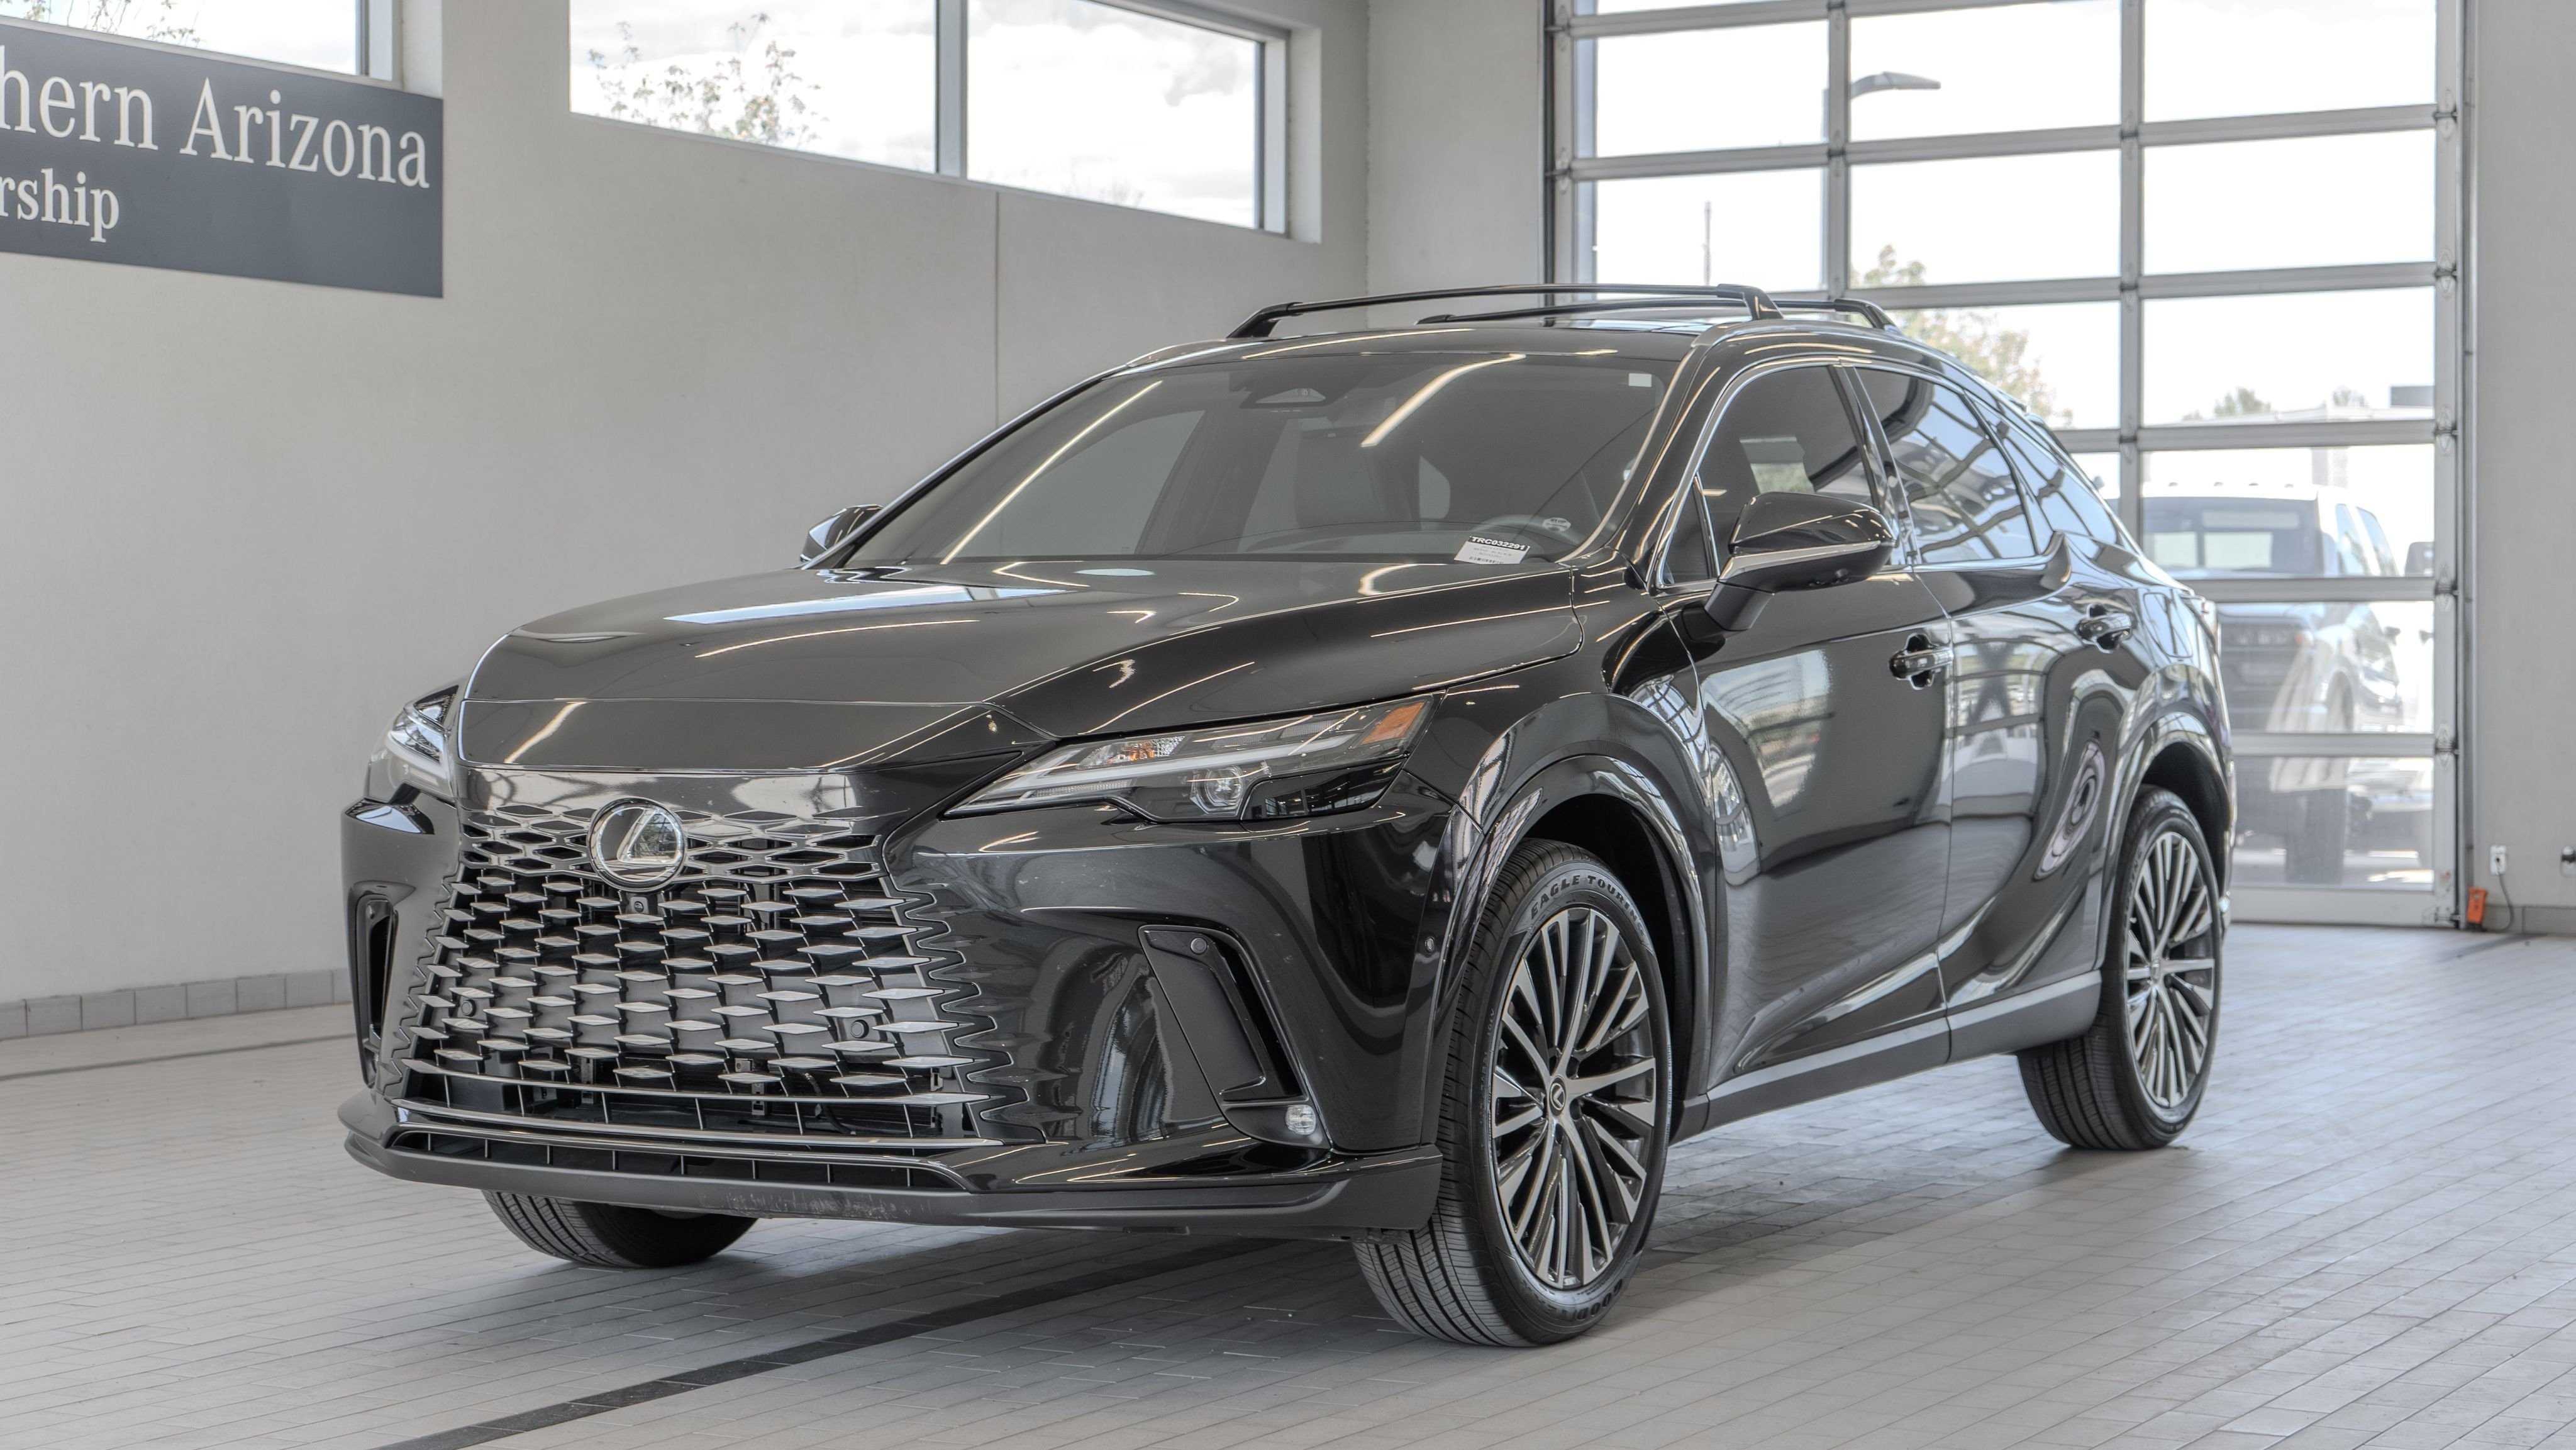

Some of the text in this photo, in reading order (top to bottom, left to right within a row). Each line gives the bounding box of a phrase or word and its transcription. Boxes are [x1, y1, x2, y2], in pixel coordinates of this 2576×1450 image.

[0, 45, 430, 188] hern Arizona
[0, 167, 119, 243] rship
[1472, 537, 1525, 550] TRC032291
[1531, 875, 1645, 937] EAGLE TOURING
